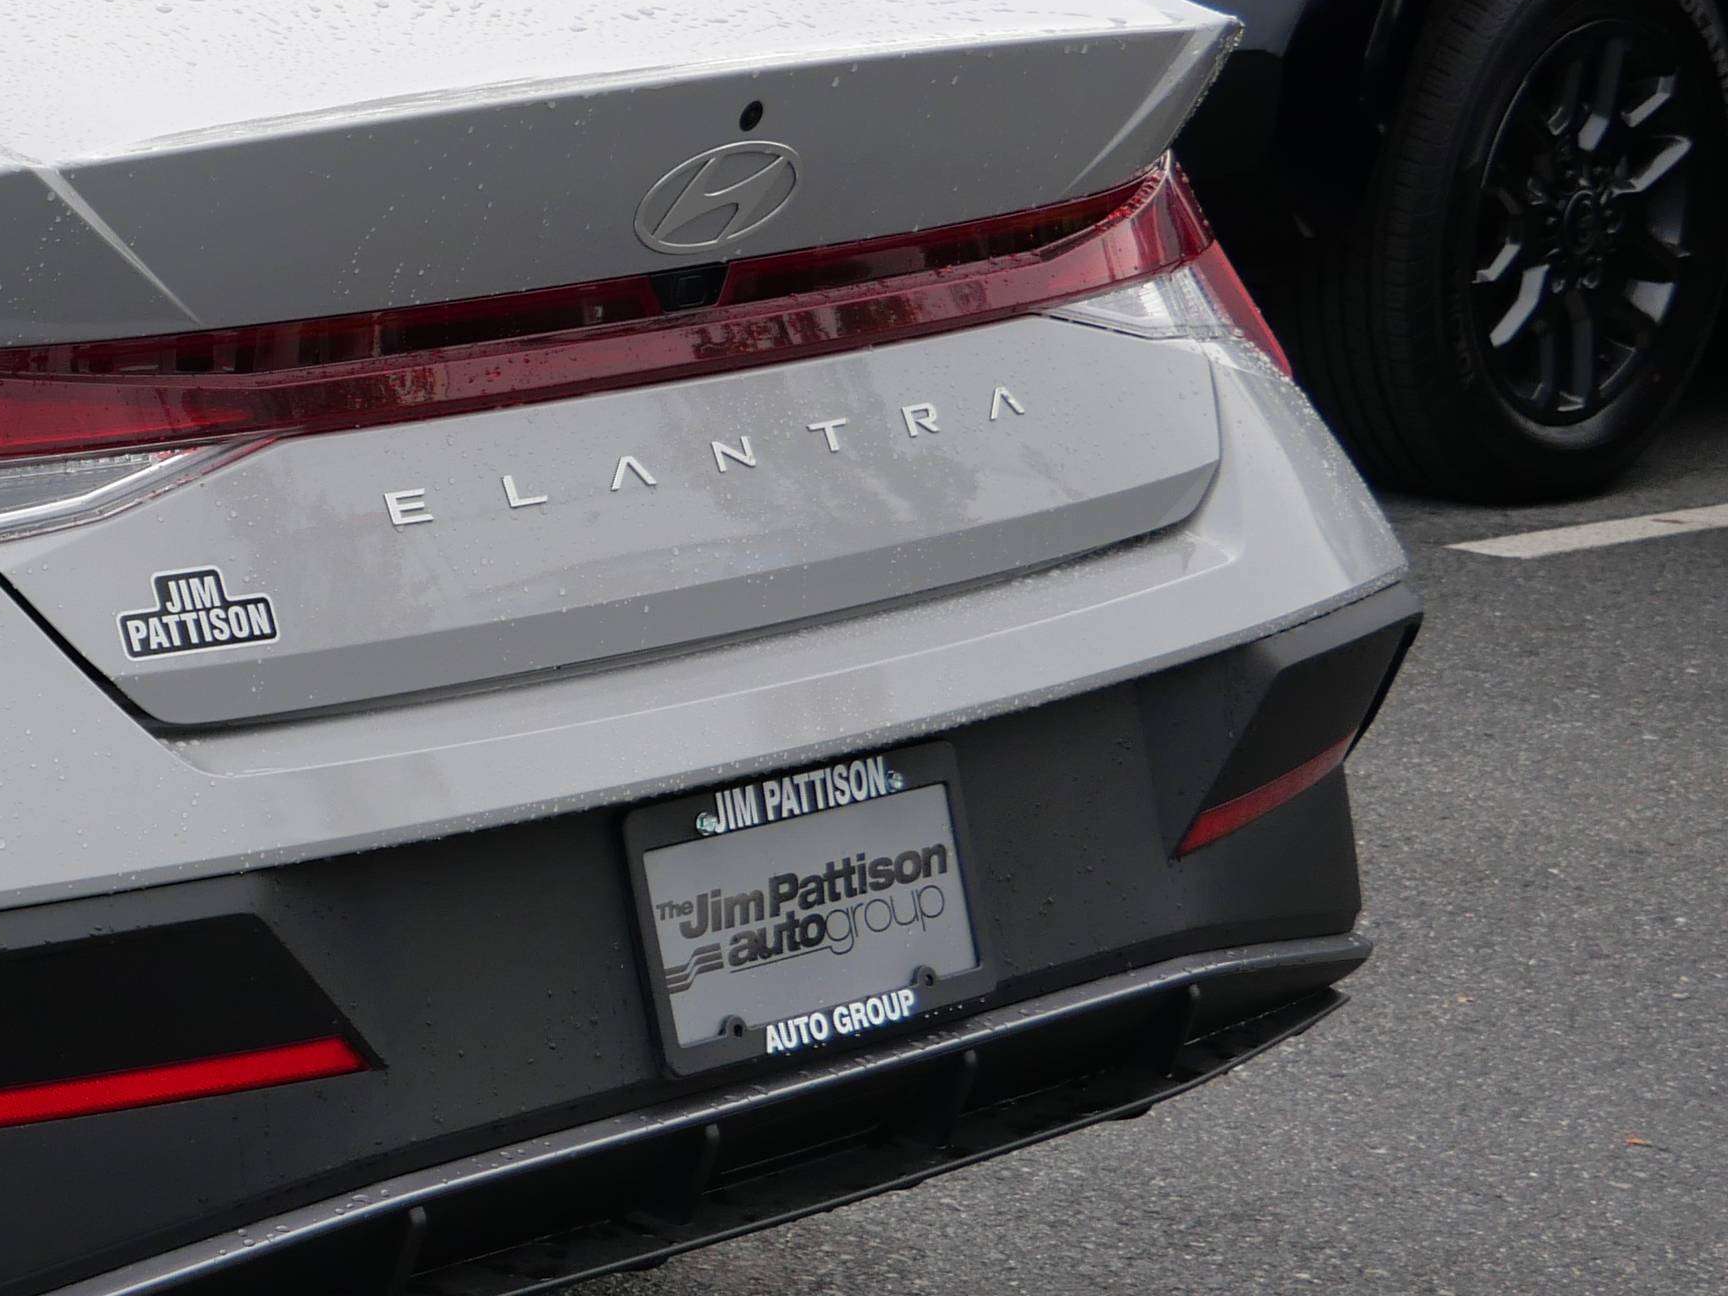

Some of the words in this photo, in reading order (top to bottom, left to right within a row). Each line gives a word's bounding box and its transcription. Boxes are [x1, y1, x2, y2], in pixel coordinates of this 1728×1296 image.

[384, 386, 1025, 526] ELANTRA
[126, 603, 273, 653] PATTISON
[165, 576, 222, 613] JIM
[713, 783, 760, 833] JIM
[763, 756, 887, 821] PATTISON
[656, 900, 694, 921] The
[679, 888, 765, 940] Jim
[768, 843, 948, 918] Pattison
[766, 1014, 829, 1054] AUTO
[833, 989, 916, 1034] GROUP
